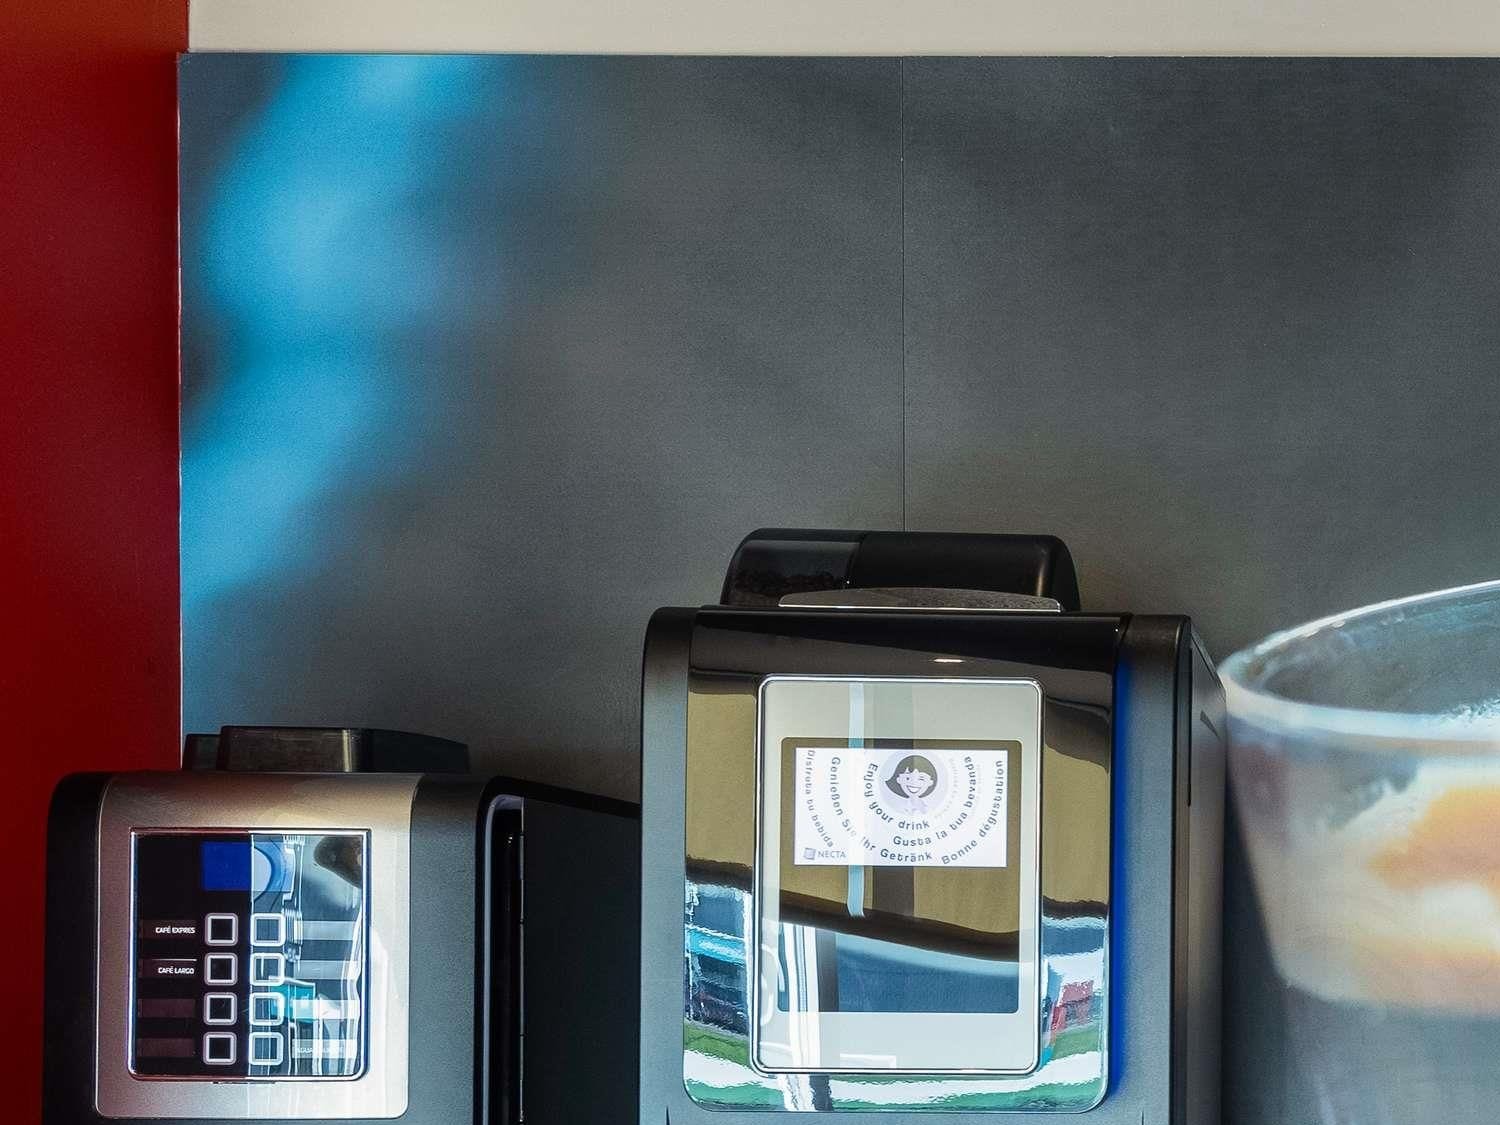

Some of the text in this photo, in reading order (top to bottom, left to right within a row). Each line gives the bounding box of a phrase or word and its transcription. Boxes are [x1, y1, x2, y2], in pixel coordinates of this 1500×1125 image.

[863, 763, 930, 831] Enjoy your drink
[893, 835, 932, 847] Gusta
[817, 850, 846, 859] NECTA
[942, 839, 978, 865] Bonne
